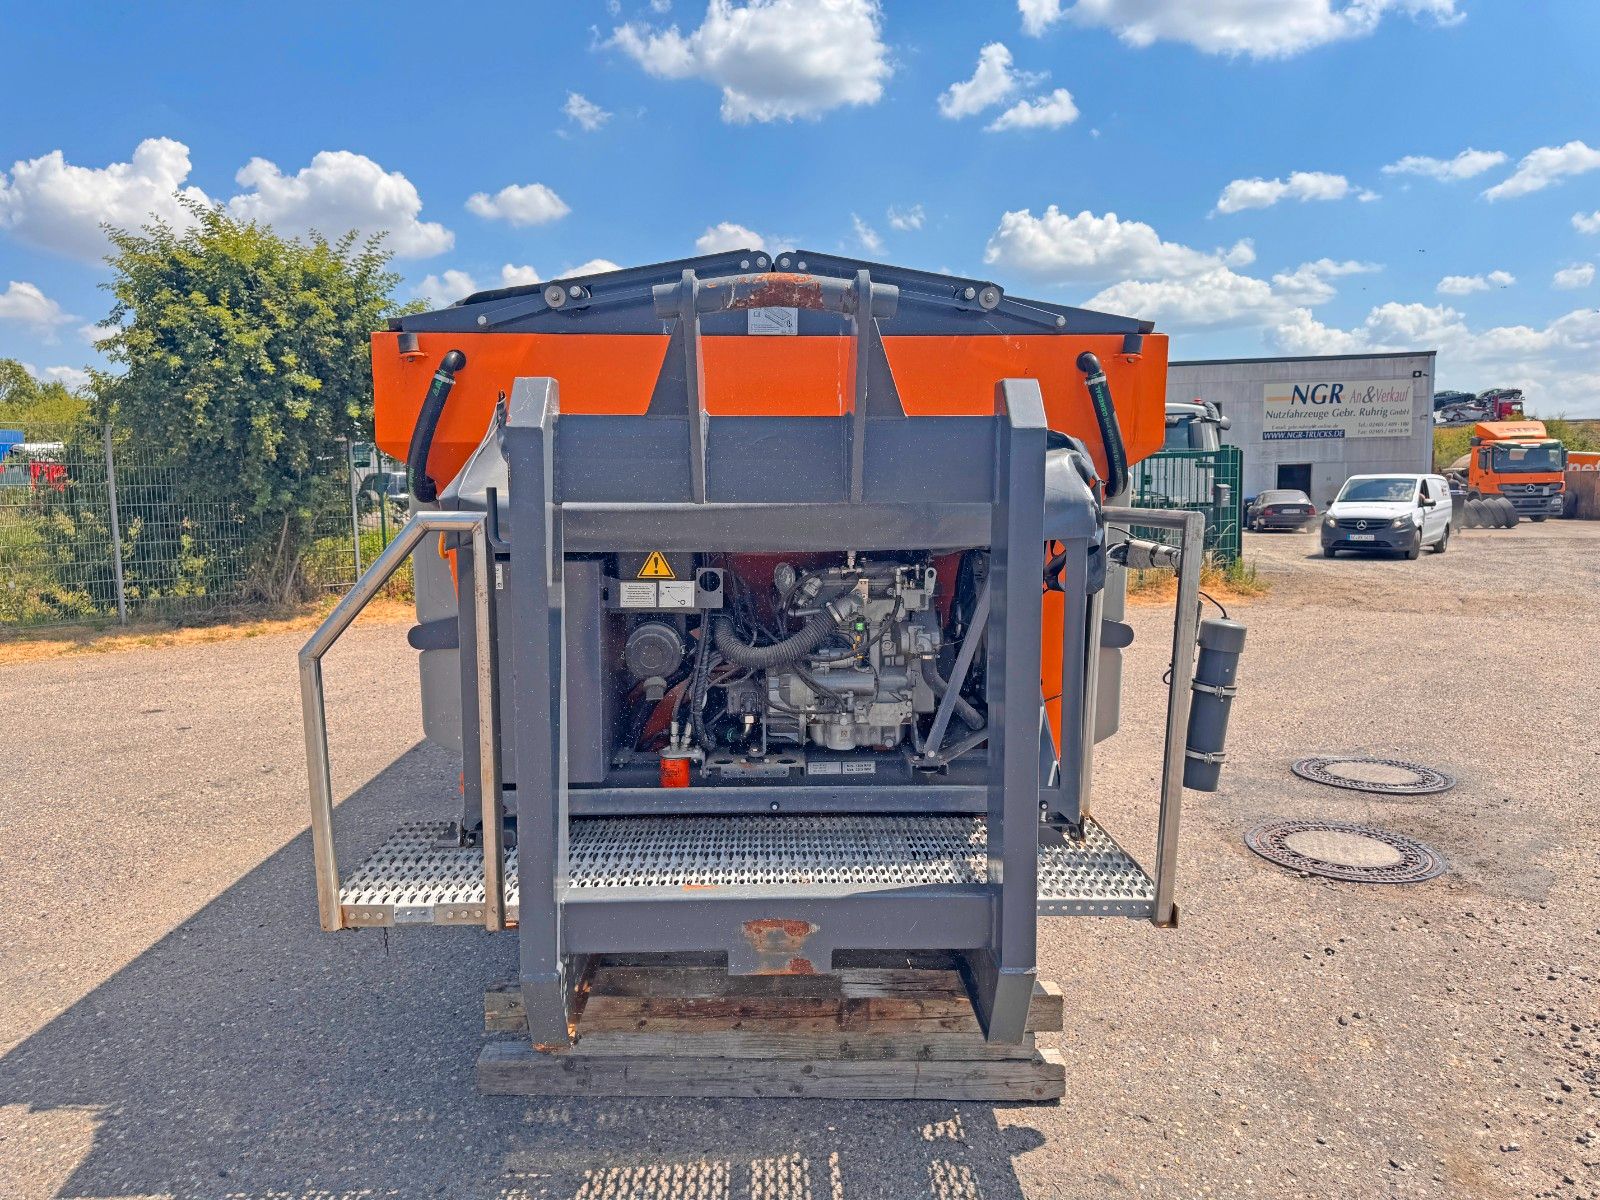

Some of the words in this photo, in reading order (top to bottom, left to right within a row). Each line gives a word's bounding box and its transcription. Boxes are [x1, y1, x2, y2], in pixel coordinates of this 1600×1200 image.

[1291, 383, 1344, 405] NGR
[1265, 408, 1329, 420] Nutzfahrzeuge
[1332, 407, 1356, 418] Gebr.
[1389, 408, 1410, 416] GmbH
[1263, 430, 1345, 440] WWW.NGR-TRUCKS.DE
